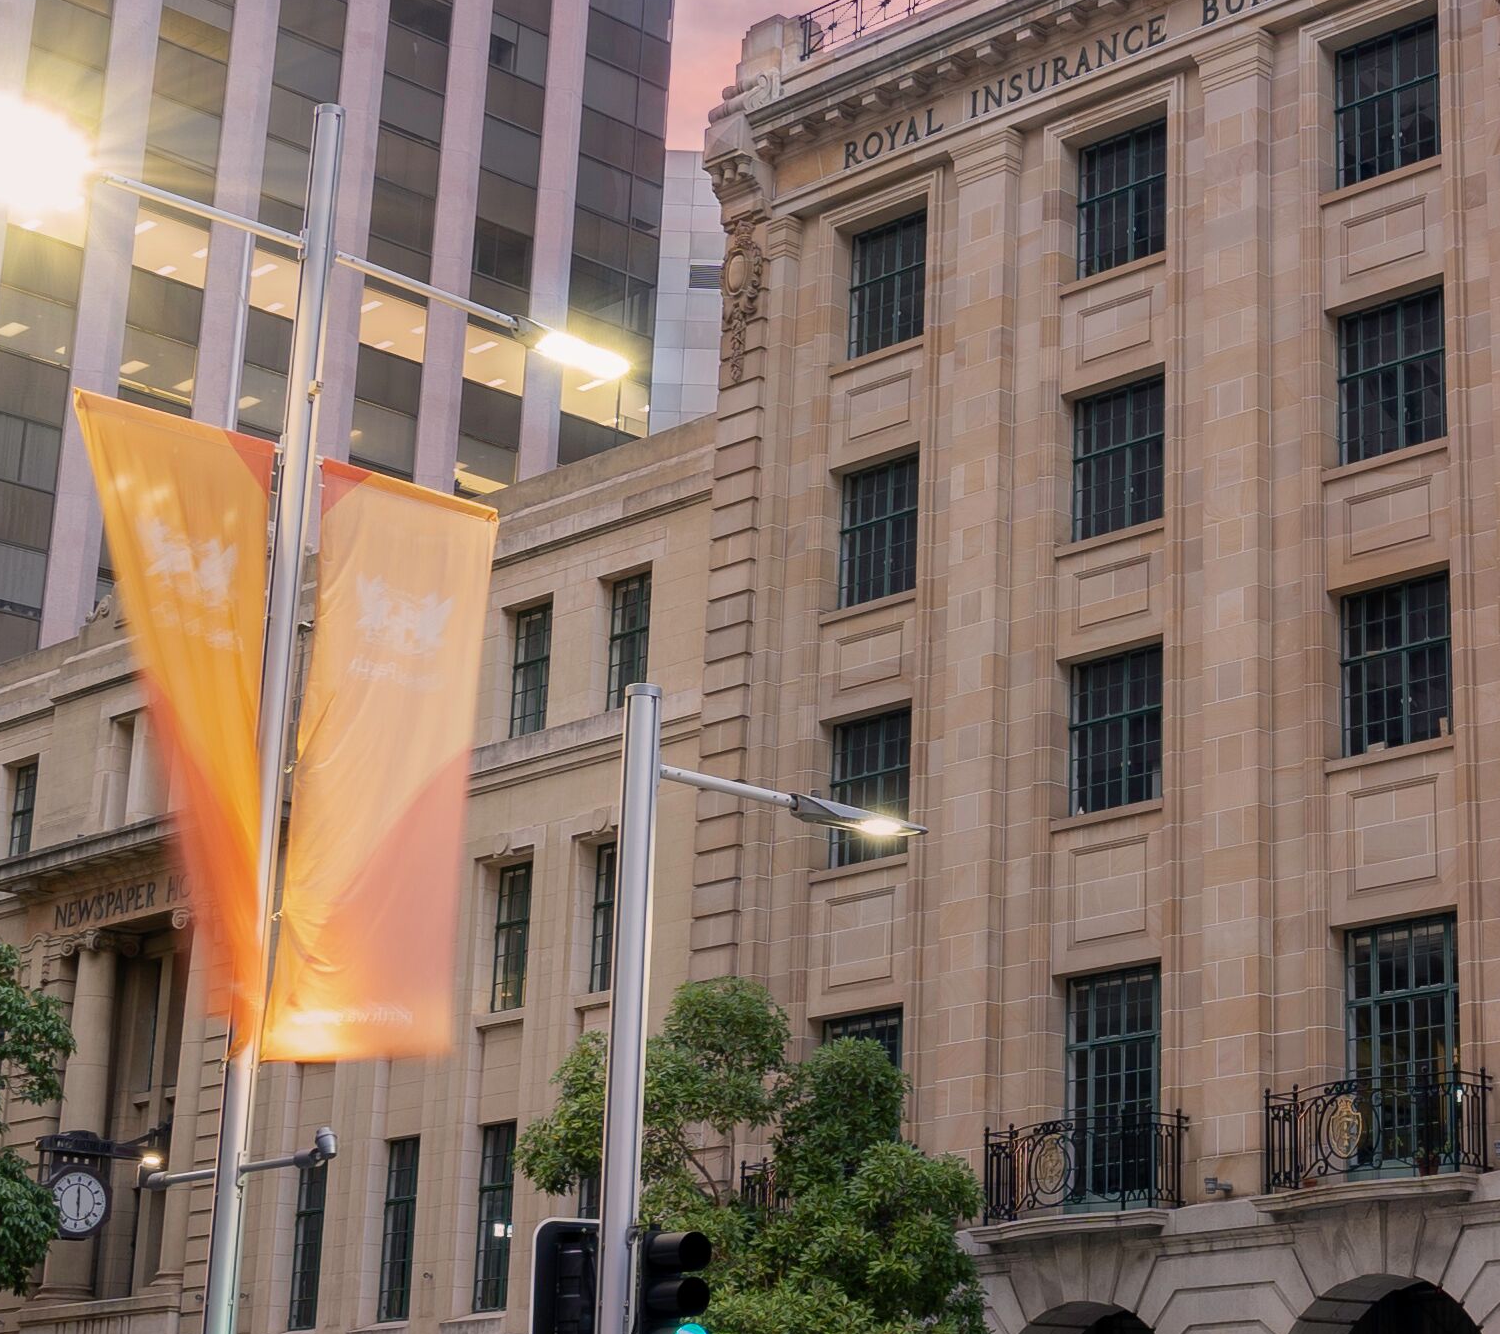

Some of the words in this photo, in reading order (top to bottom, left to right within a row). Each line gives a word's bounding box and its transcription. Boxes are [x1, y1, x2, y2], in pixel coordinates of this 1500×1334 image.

[843, 107, 943, 170] ROYAL
[970, 13, 1168, 119] INSURANCE
[54, 881, 156, 931] NEWSPAPER
